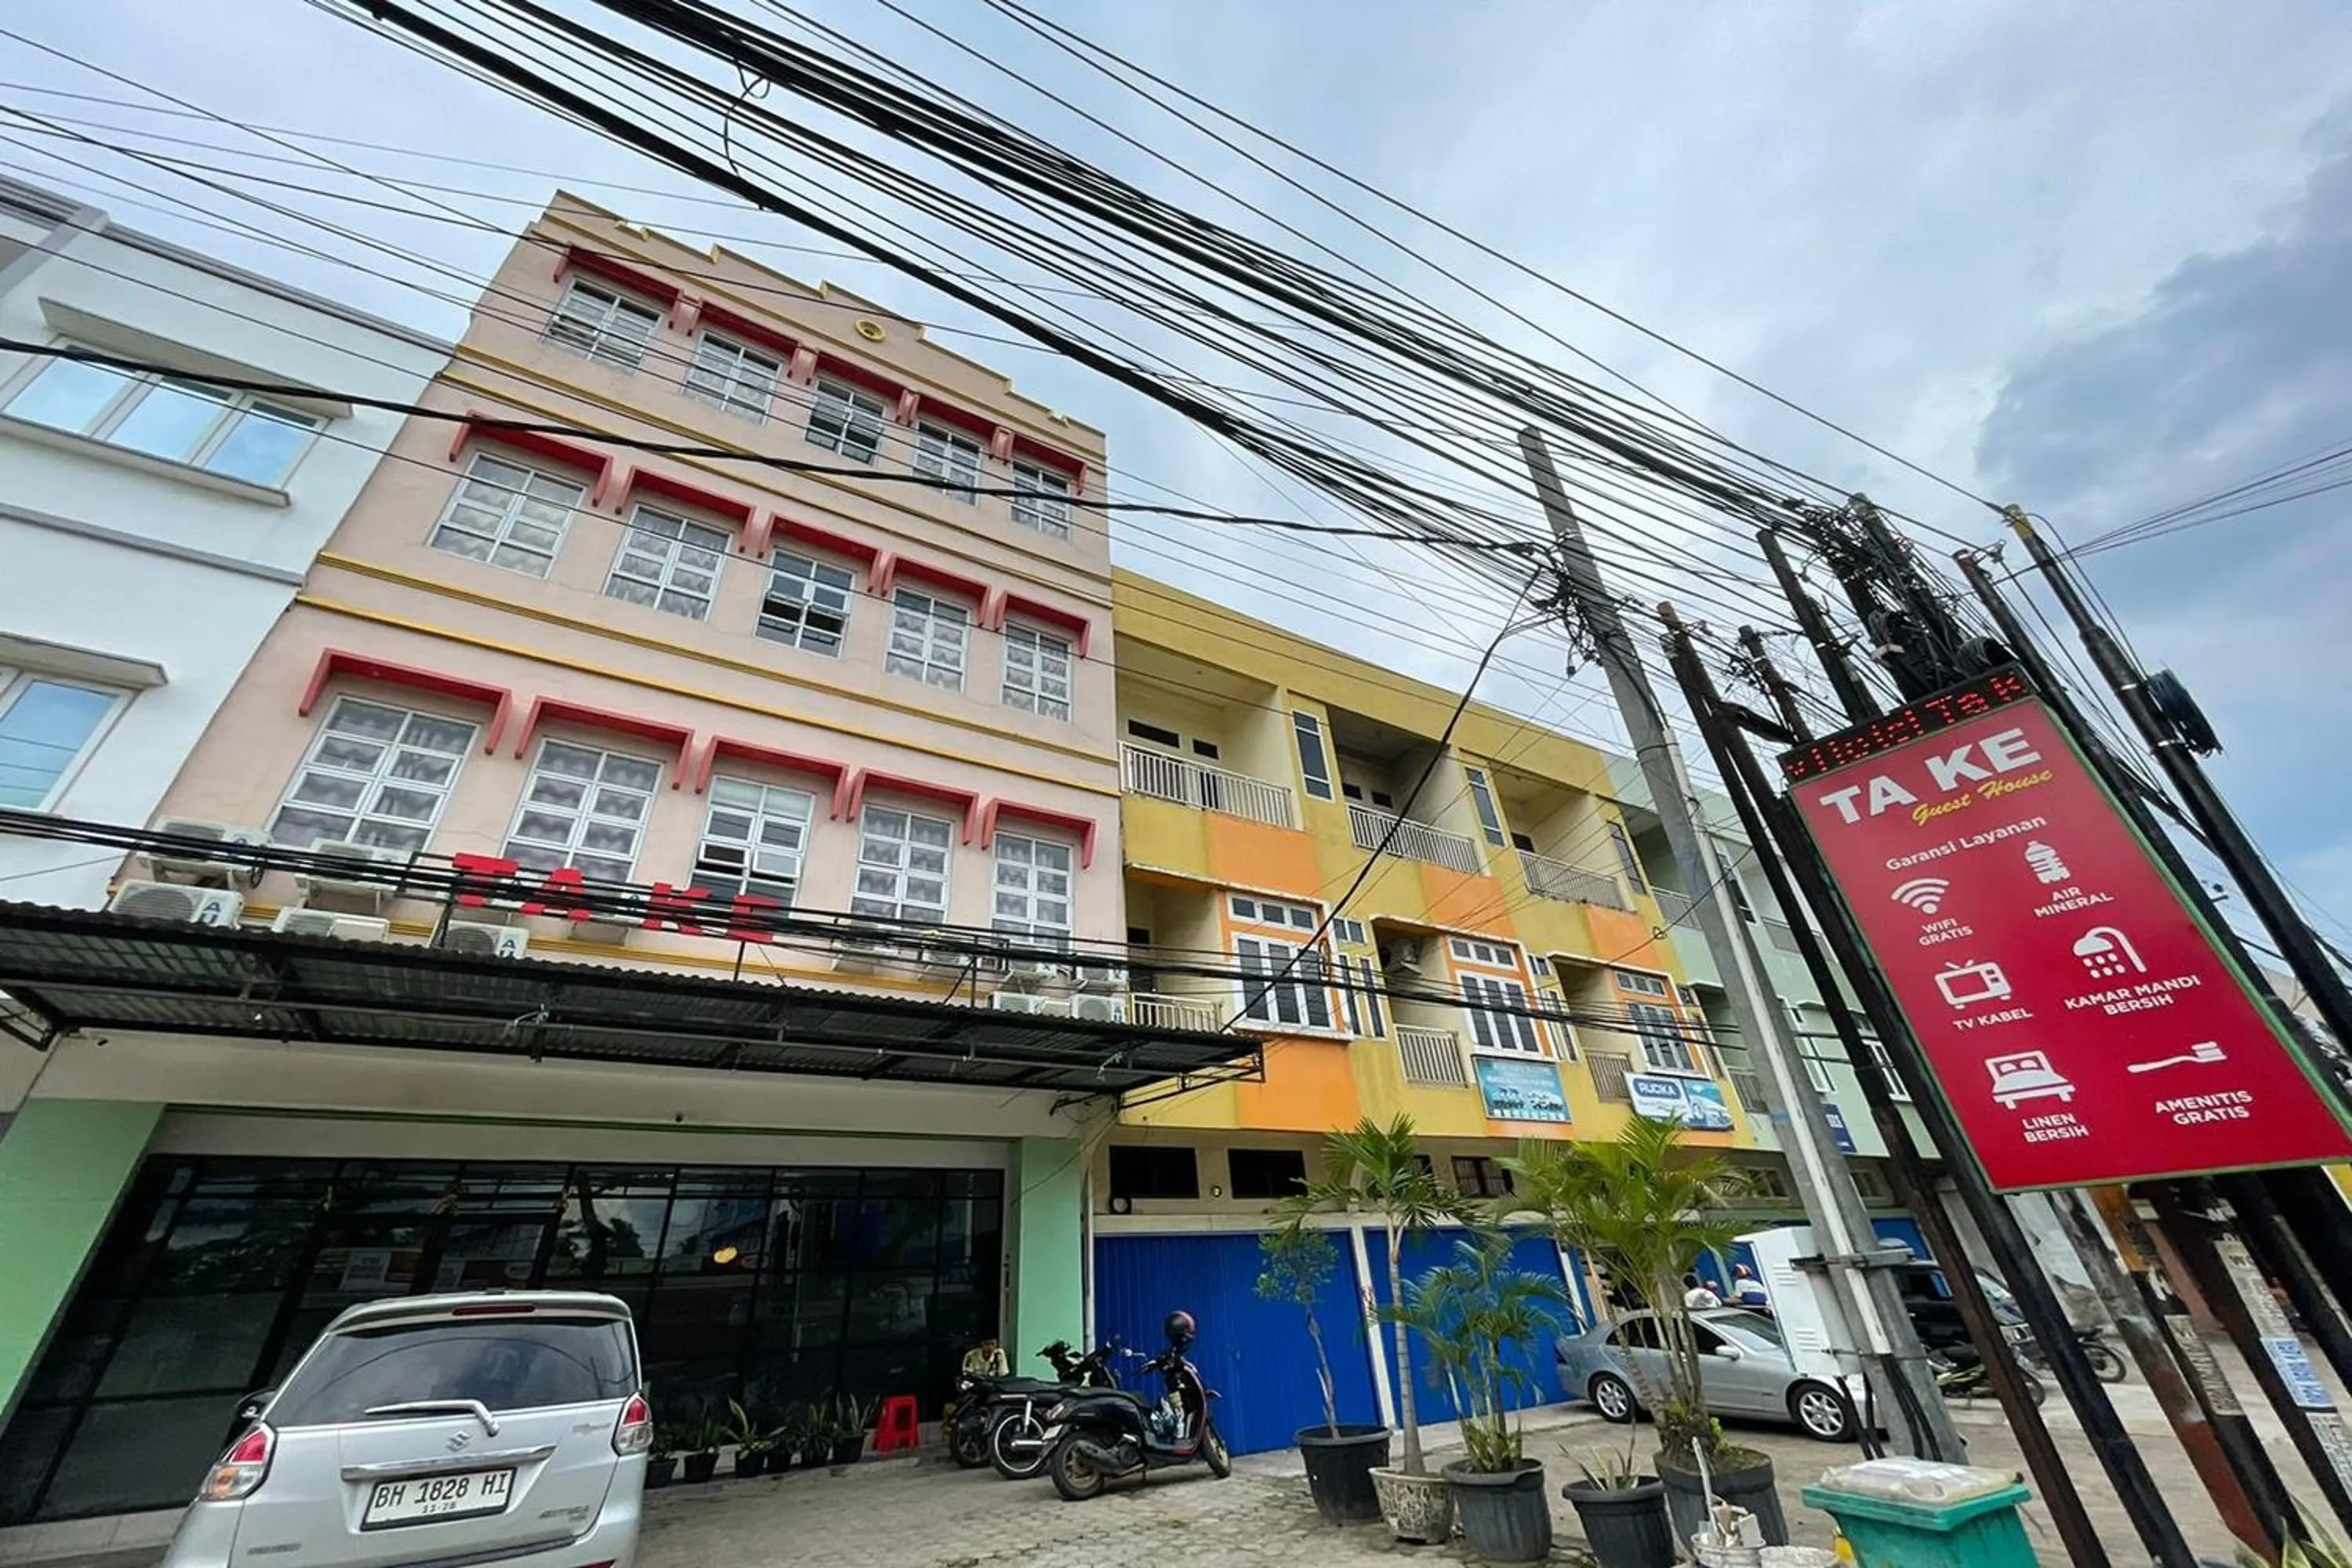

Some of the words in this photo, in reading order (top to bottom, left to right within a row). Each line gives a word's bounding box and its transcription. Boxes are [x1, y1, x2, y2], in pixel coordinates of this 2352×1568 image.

[1819, 775, 1918, 823] TA
[1924, 728, 2042, 792] KE
[1912, 793, 1972, 826] Guest
[1976, 769, 2053, 800] House
[1886, 840, 1958, 870] Garansi
[1959, 815, 2047, 849] Layanan
[2034, 892, 2114, 917] MINERAL
[2052, 887, 2083, 902] AIR
[1918, 926, 1973, 946] GRATIS
[1922, 918, 1958, 935] WIFI
[2064, 989, 2132, 1010] KAMAR
[2134, 975, 2201, 996] MANDI
[2103, 993, 2174, 1016] BERSIH
[1953, 1018, 1976, 1031] TV
[1977, 1007, 2034, 1027] KABEL
[2155, 1090, 2254, 1114] AMENITIS
[2022, 1112, 2077, 1131] LINEN
[2172, 1105, 2251, 1126] GRATIS
[2023, 1125, 2089, 1143] BERSIH
[375, 1485, 406, 1508] BH
[414, 1477, 470, 1504] 1828
[481, 1472, 508, 1496] HI
